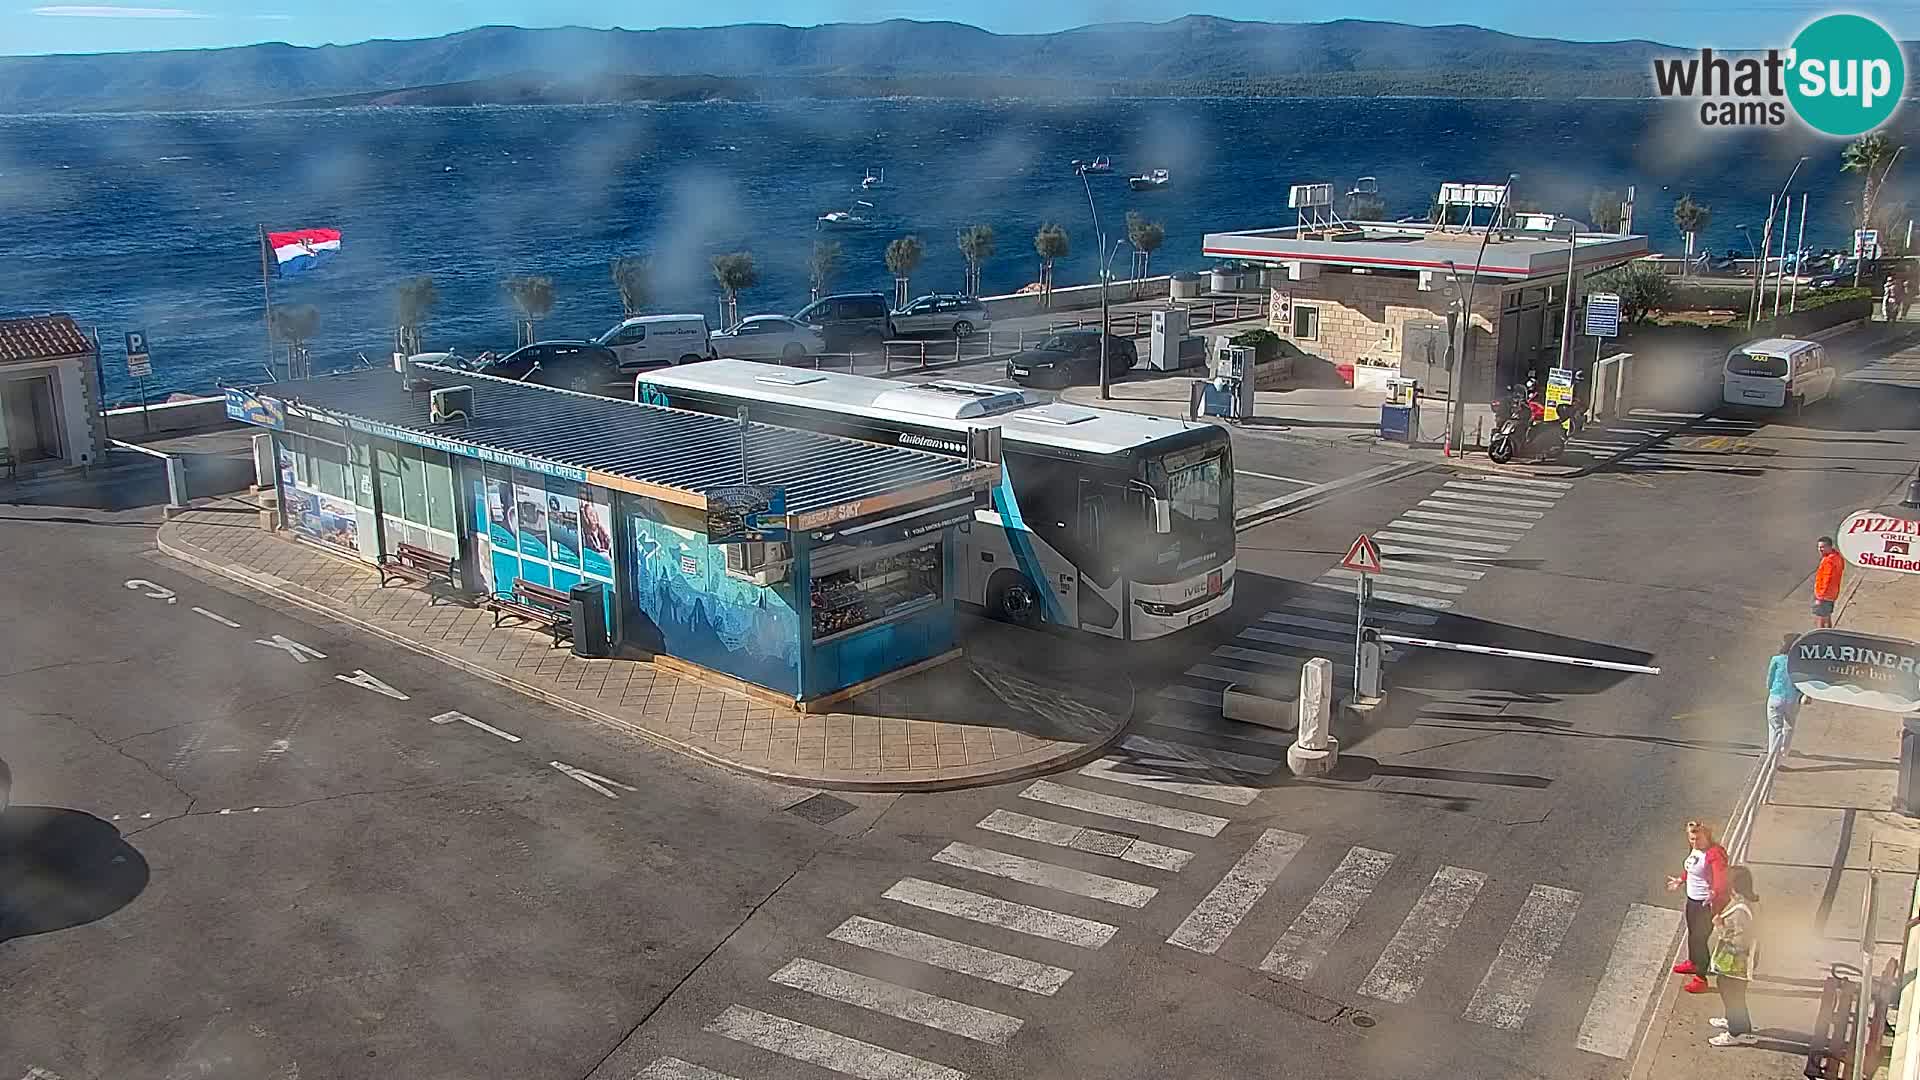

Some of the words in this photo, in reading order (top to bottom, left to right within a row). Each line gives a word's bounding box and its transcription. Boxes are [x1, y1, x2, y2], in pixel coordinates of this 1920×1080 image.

[130, 333, 143, 352] P
[1750, 353, 1768, 362] TAXI
[478, 449, 492, 462] BUS
[493, 453, 526, 468] STATION
[529, 460, 554, 473] TICKET
[556, 466, 583, 480] OFFICE
[1881, 533, 1916, 543] GRILL
